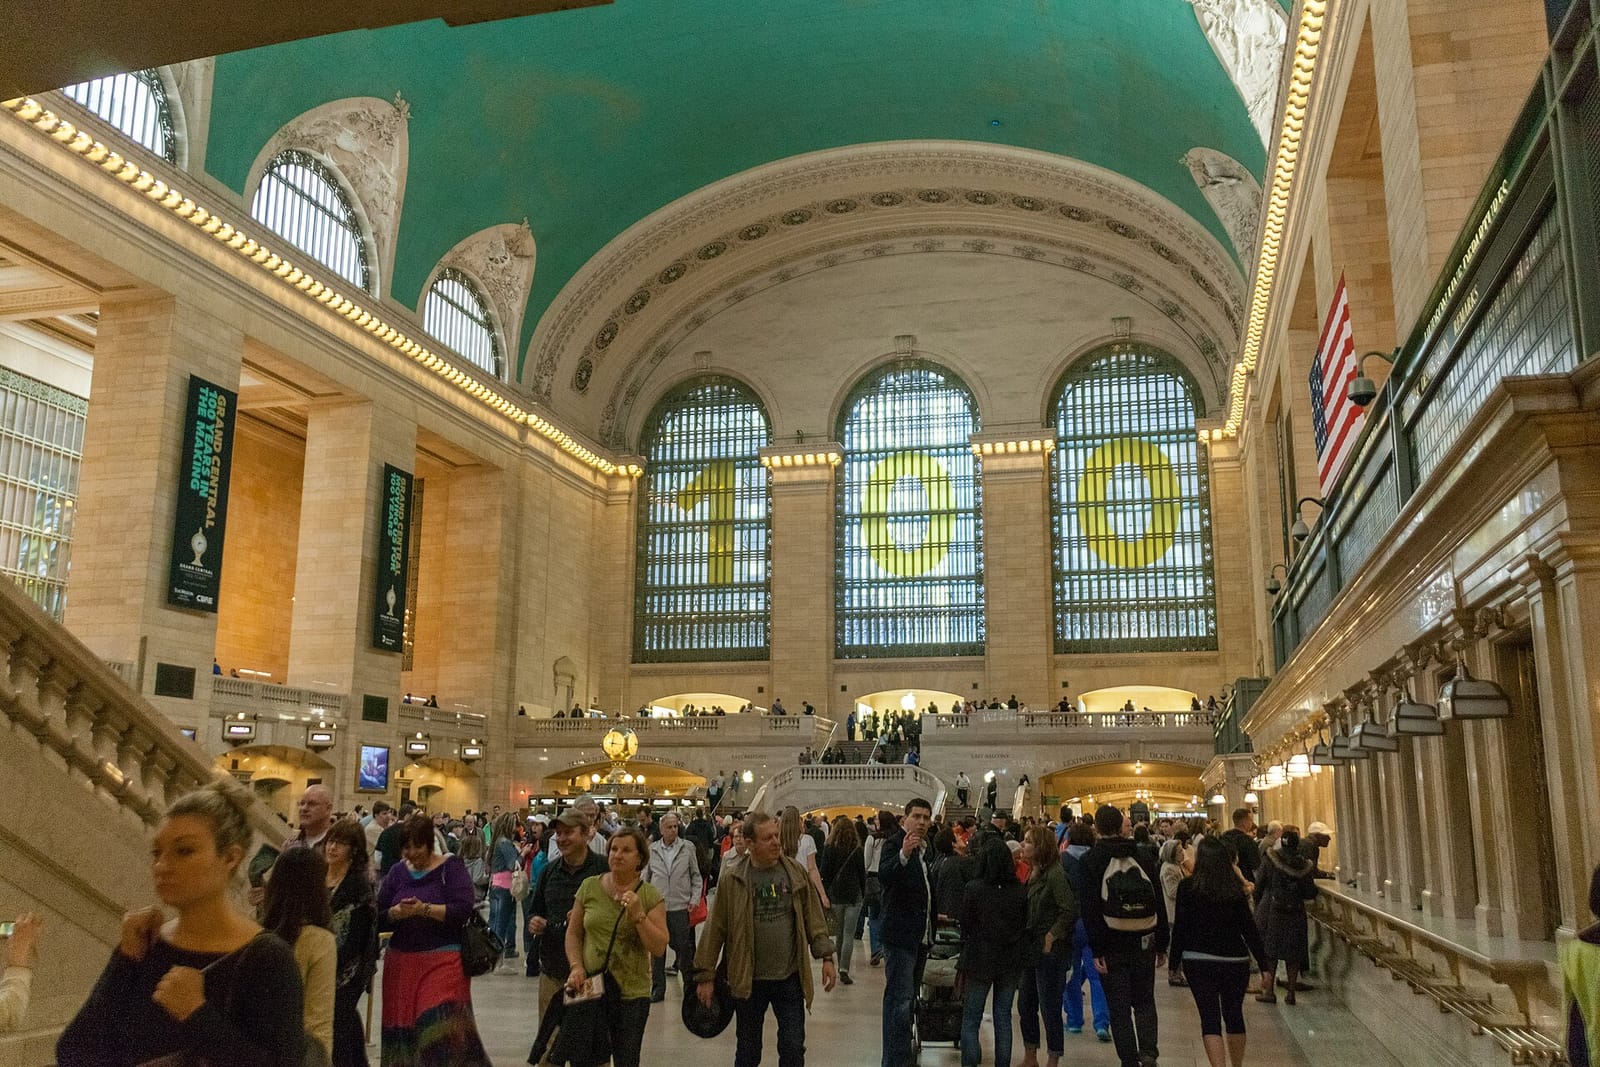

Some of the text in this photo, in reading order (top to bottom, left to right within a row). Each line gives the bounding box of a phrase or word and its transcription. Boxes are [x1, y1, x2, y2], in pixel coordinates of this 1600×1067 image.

[1453, 284, 1479, 337] REMARKS
[190, 386, 209, 490] THE MAKING
[198, 390, 218, 498] 100 YEARS IN
[205, 394, 227, 529] GRAND CENTRAL
[387, 496, 396, 537] YEARS
[392, 474, 401, 525] MOVING
[391, 528, 398, 544] US
[394, 478, 407, 577] GRAND CENTRAL
[1063, 752, 1106, 767] LEXINGTON
[1149, 751, 1173, 760] TICKET
